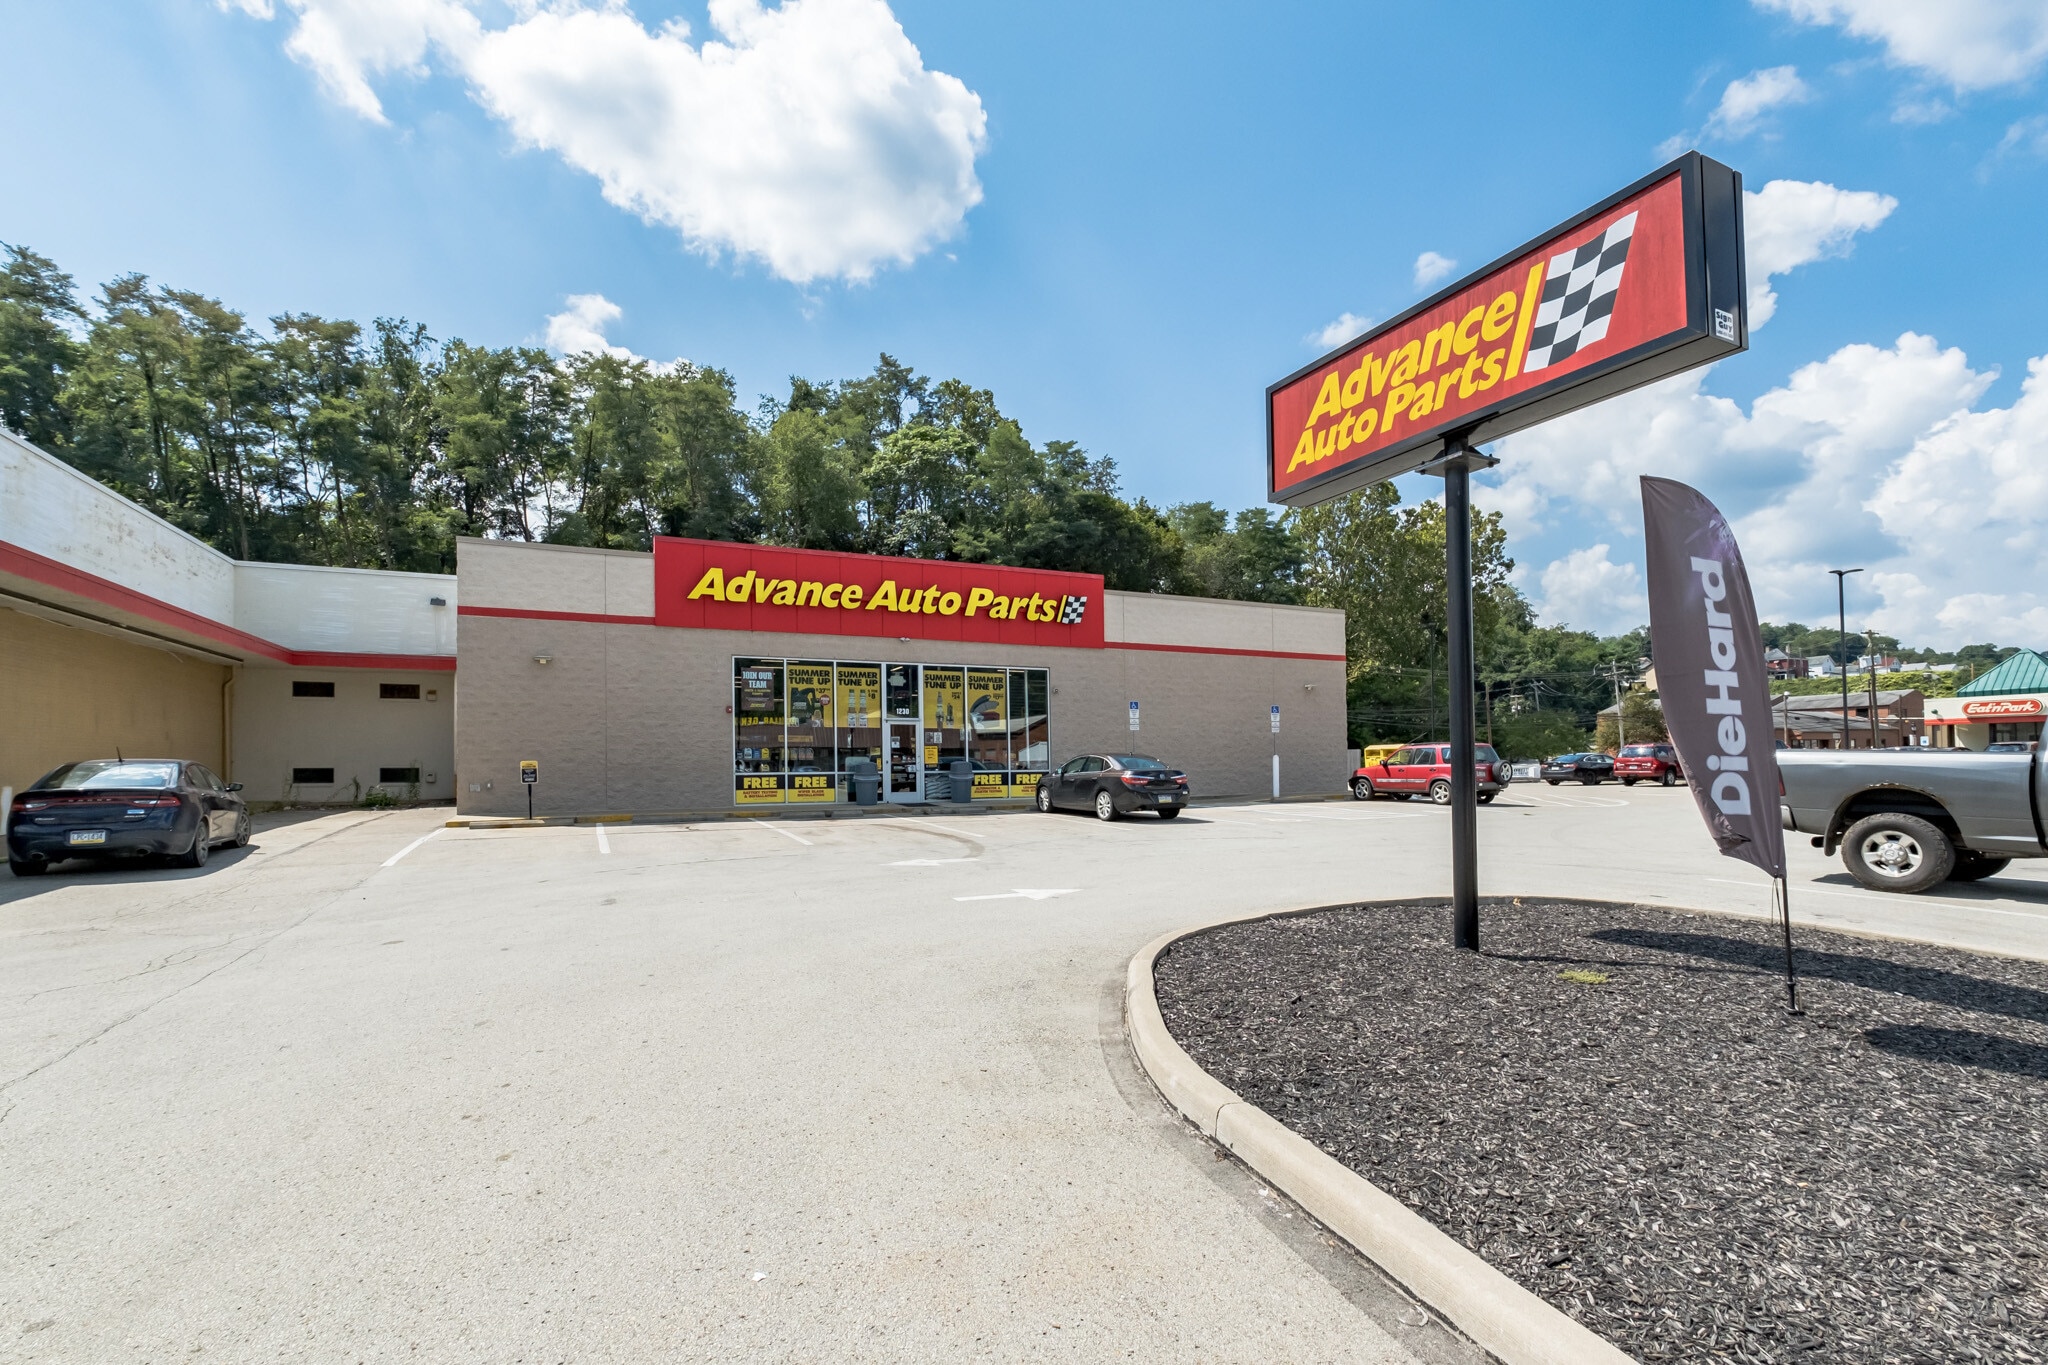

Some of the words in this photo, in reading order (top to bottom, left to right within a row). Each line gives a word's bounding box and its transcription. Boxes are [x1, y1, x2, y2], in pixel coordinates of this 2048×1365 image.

[1305, 291, 1517, 429] Advance
[1286, 406, 1378, 474] Auto
[1380, 347, 1506, 433] Parts
[687, 567, 863, 608] Advance
[865, 580, 963, 616] Auto
[964, 587, 1058, 622] Parts
[742, 671, 758, 680] JOIN
[758, 671, 773, 680] OUR
[788, 669, 830, 678] SUMMER
[837, 671, 878, 679] SUMMER
[924, 674, 961, 682] SUMMER
[748, 680, 767, 689] TEAM
[788, 677, 814, 685] TUNE
[817, 678, 831, 686] UP
[837, 679, 862, 687] TUNE
[968, 676, 1004, 684] SUMMER
[924, 681, 946, 689] TUNE
[1690, 556, 1752, 816] DieHard
[743, 777, 778, 789] FREE
[794, 776, 828, 788] FREE
[974, 774, 1002, 785] FREE
